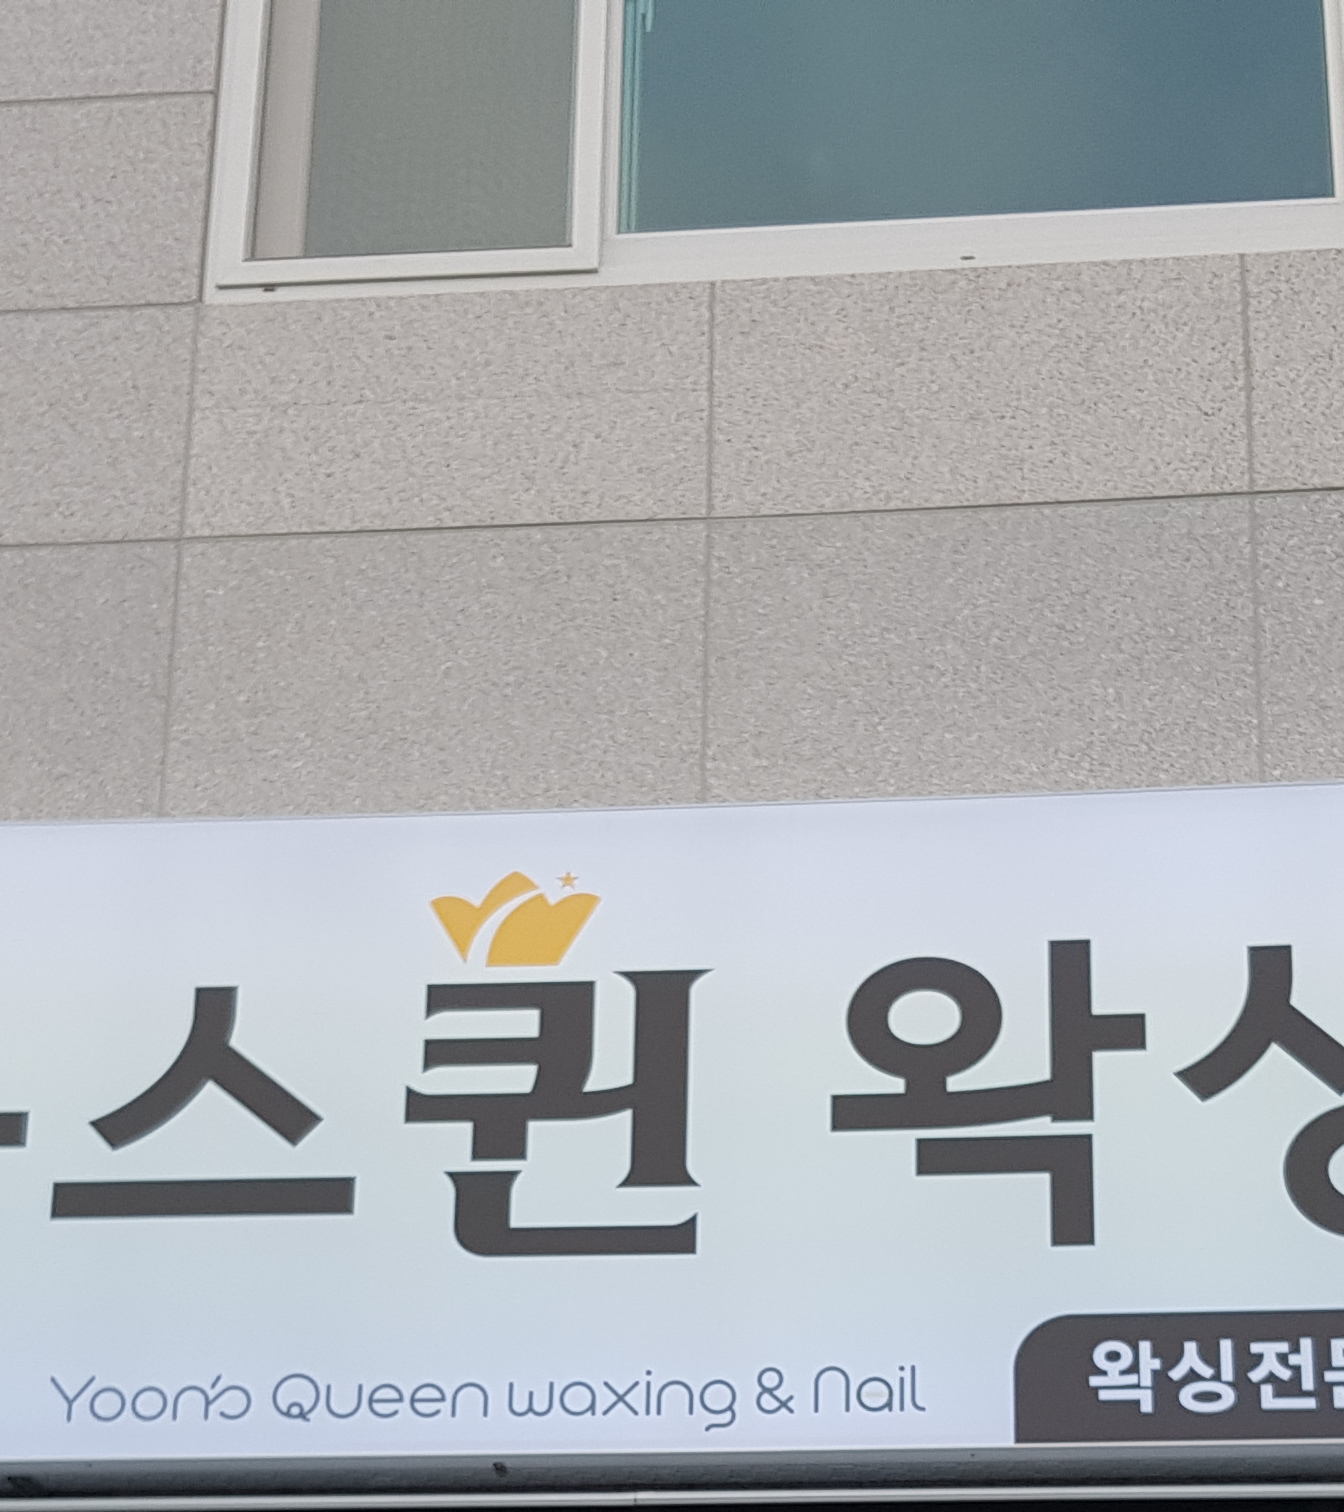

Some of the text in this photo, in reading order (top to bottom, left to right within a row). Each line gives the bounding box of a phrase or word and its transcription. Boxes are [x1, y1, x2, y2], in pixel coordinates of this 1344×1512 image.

[271, 1372, 490, 1423] Queen
[754, 1366, 796, 1416] &
[812, 1363, 927, 1414] Nail
